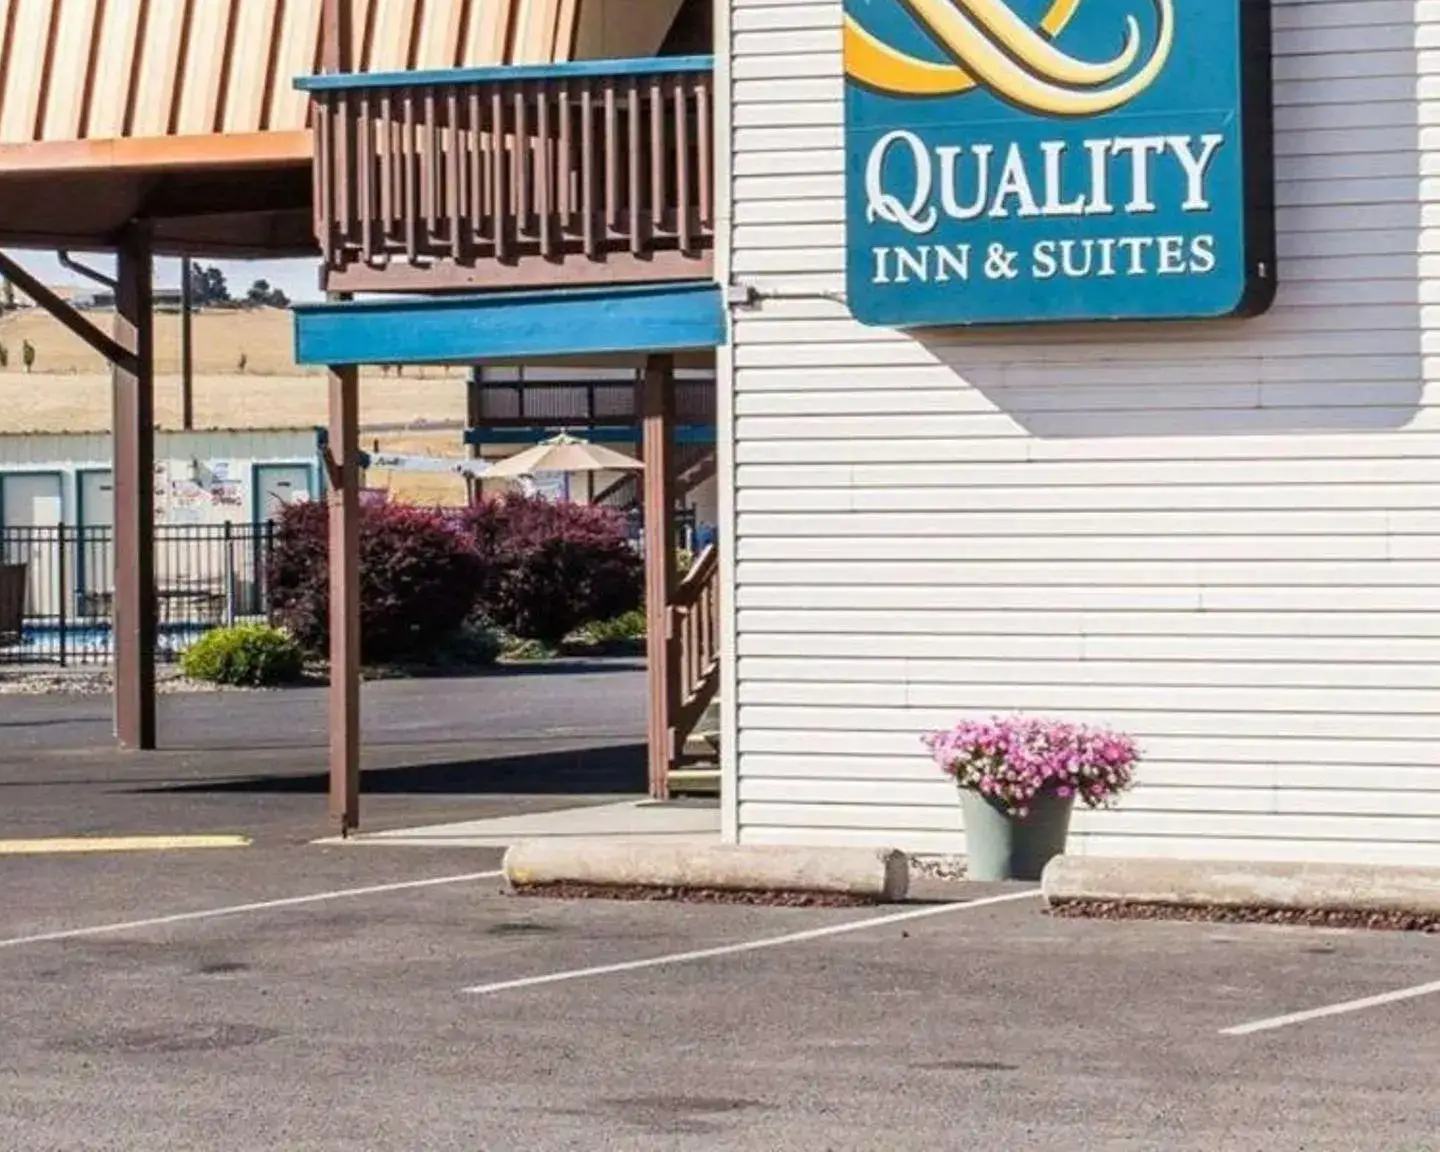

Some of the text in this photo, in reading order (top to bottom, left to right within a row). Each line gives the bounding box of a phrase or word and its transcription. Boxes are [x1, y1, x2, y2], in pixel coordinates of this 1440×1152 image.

[865, 130, 1224, 234] QUALITY
[872, 235, 1216, 283] INN & SUITES
